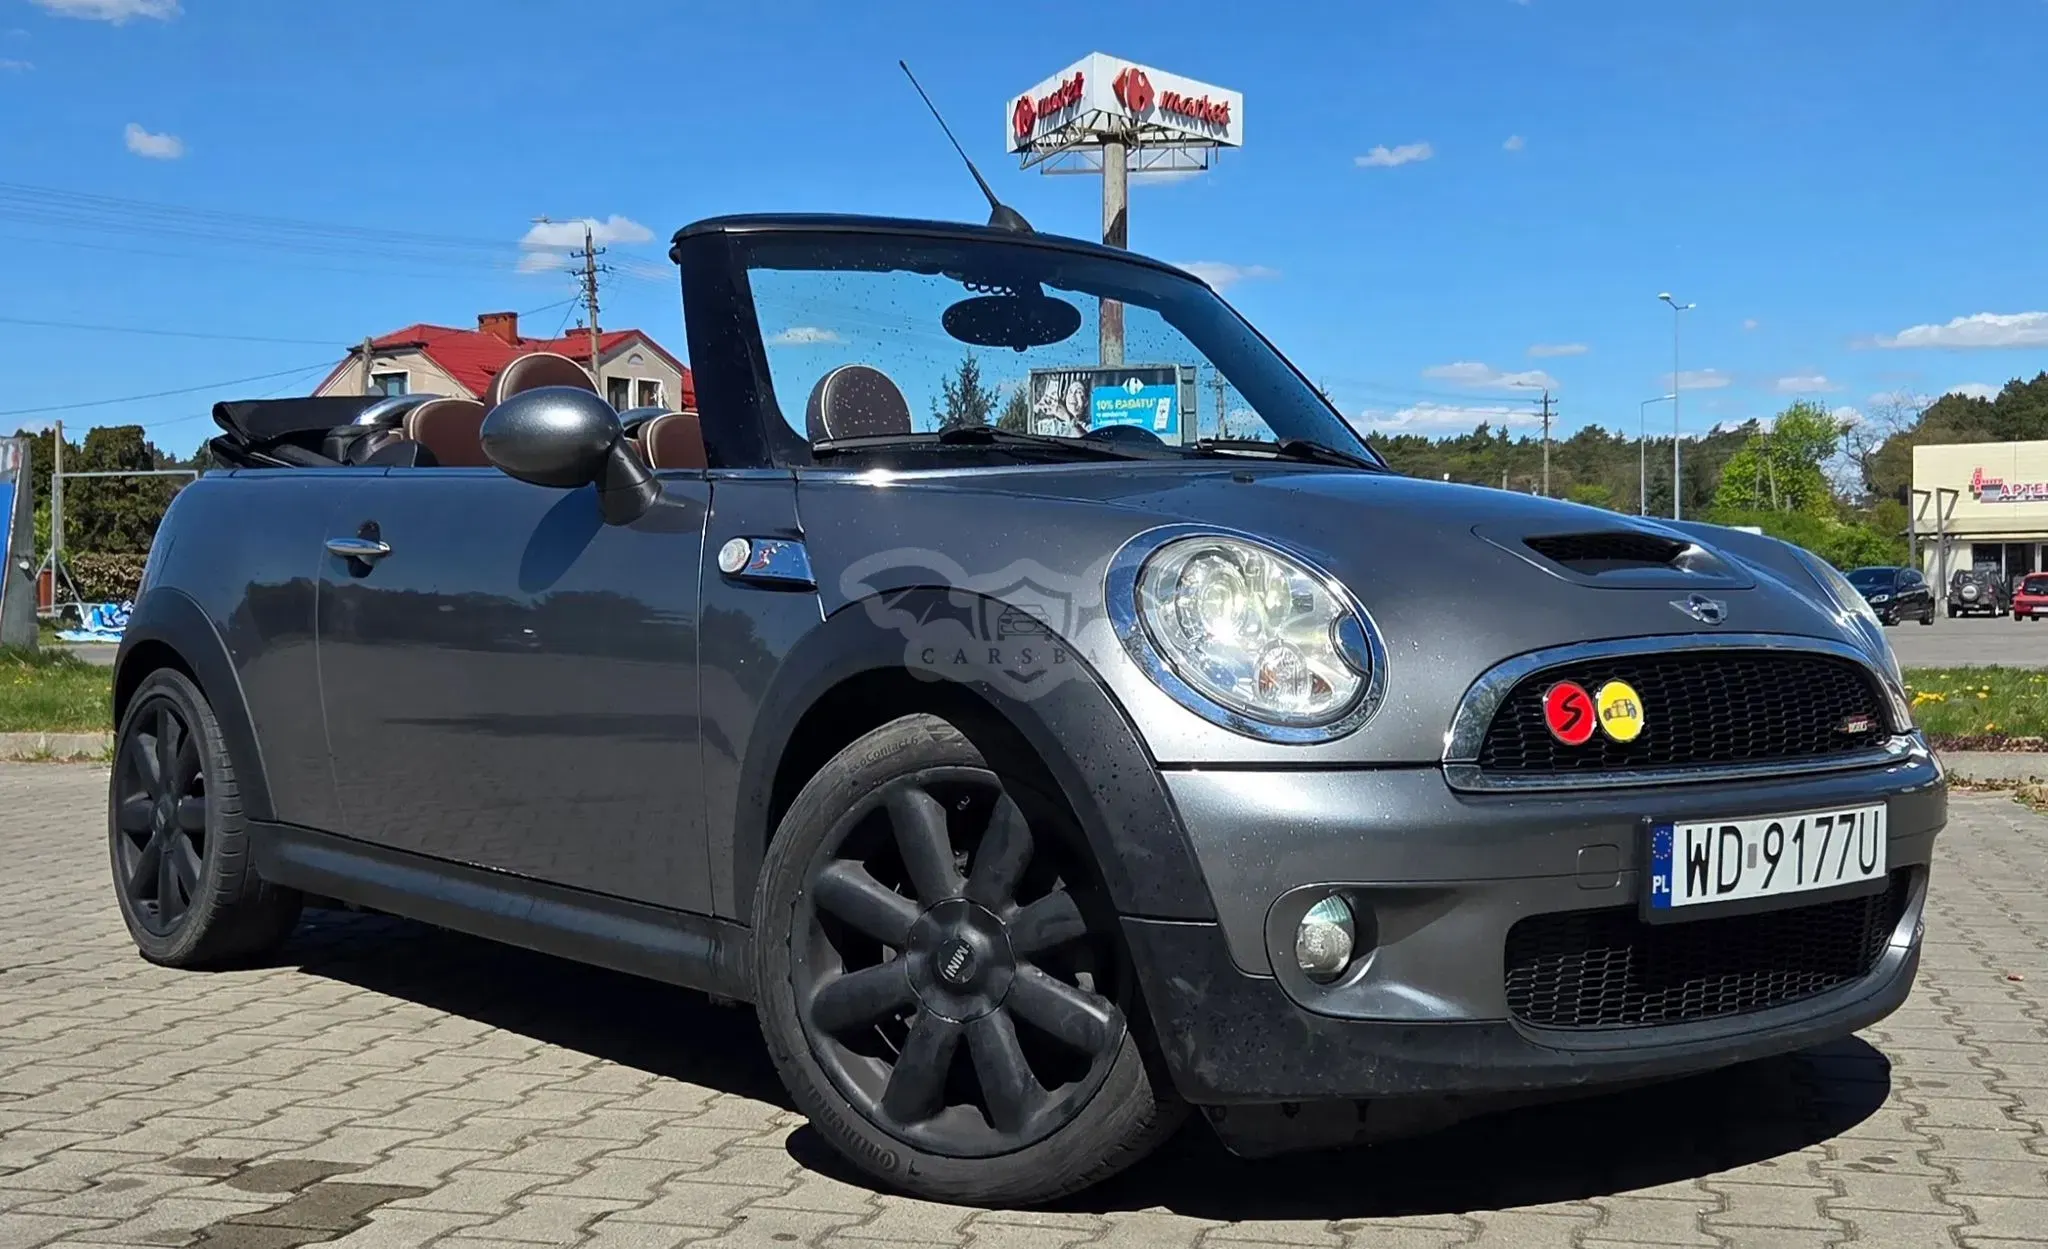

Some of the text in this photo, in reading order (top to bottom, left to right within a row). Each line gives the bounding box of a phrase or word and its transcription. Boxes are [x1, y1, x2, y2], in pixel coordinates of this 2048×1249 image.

[1159, 90, 1231, 126] market
[1560, 693, 1582, 732] S
[1686, 810, 1879, 898] WD 9177U
[1652, 875, 1669, 895] PL
[945, 945, 969, 978] MINI
